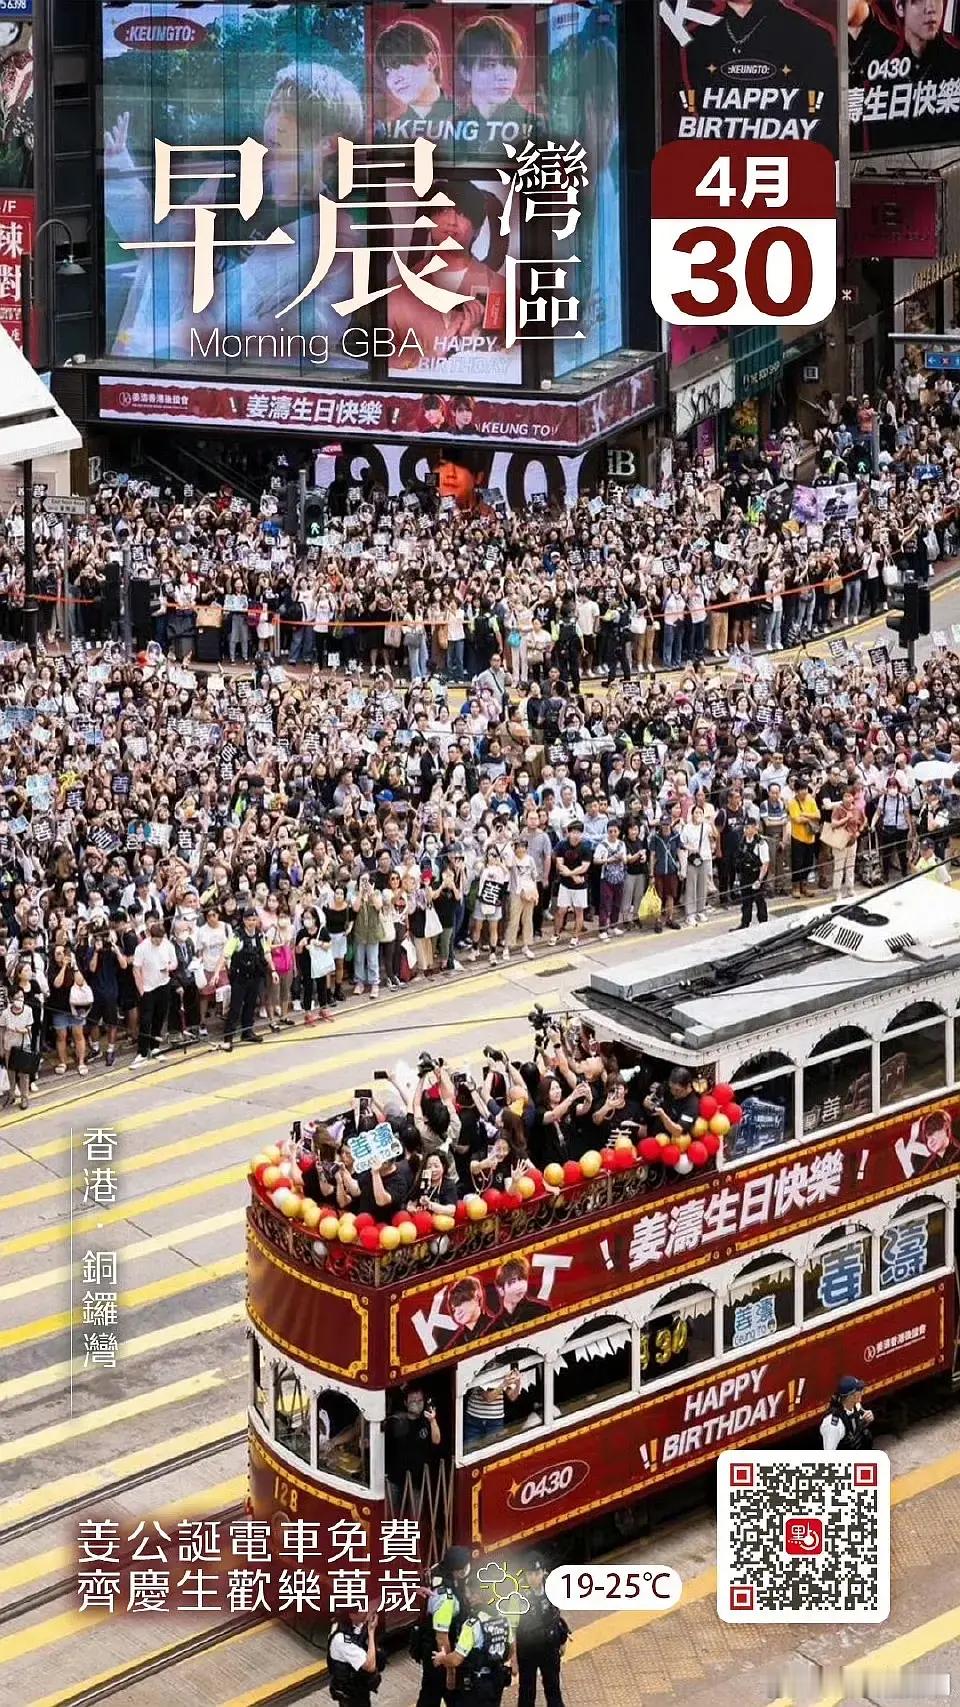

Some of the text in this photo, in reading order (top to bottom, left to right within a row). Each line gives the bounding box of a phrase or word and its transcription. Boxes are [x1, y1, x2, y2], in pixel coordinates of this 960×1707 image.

[867, 57, 912, 80] 0430
[702, 87, 800, 110] HAPPY
[678, 116, 821, 140] BIRTHDAY
[433, 335, 498, 352] HAPPY
[246, 393, 384, 426] 姜濤生日快樂
[628, 1148, 846, 1273] 姜濤生日快樂
[683, 1364, 770, 1422] HAPPY
[661, 1393, 786, 1464] BIRTHDAY
[273, 1475, 299, 1513] 128
[520, 1464, 574, 1506] 0430
